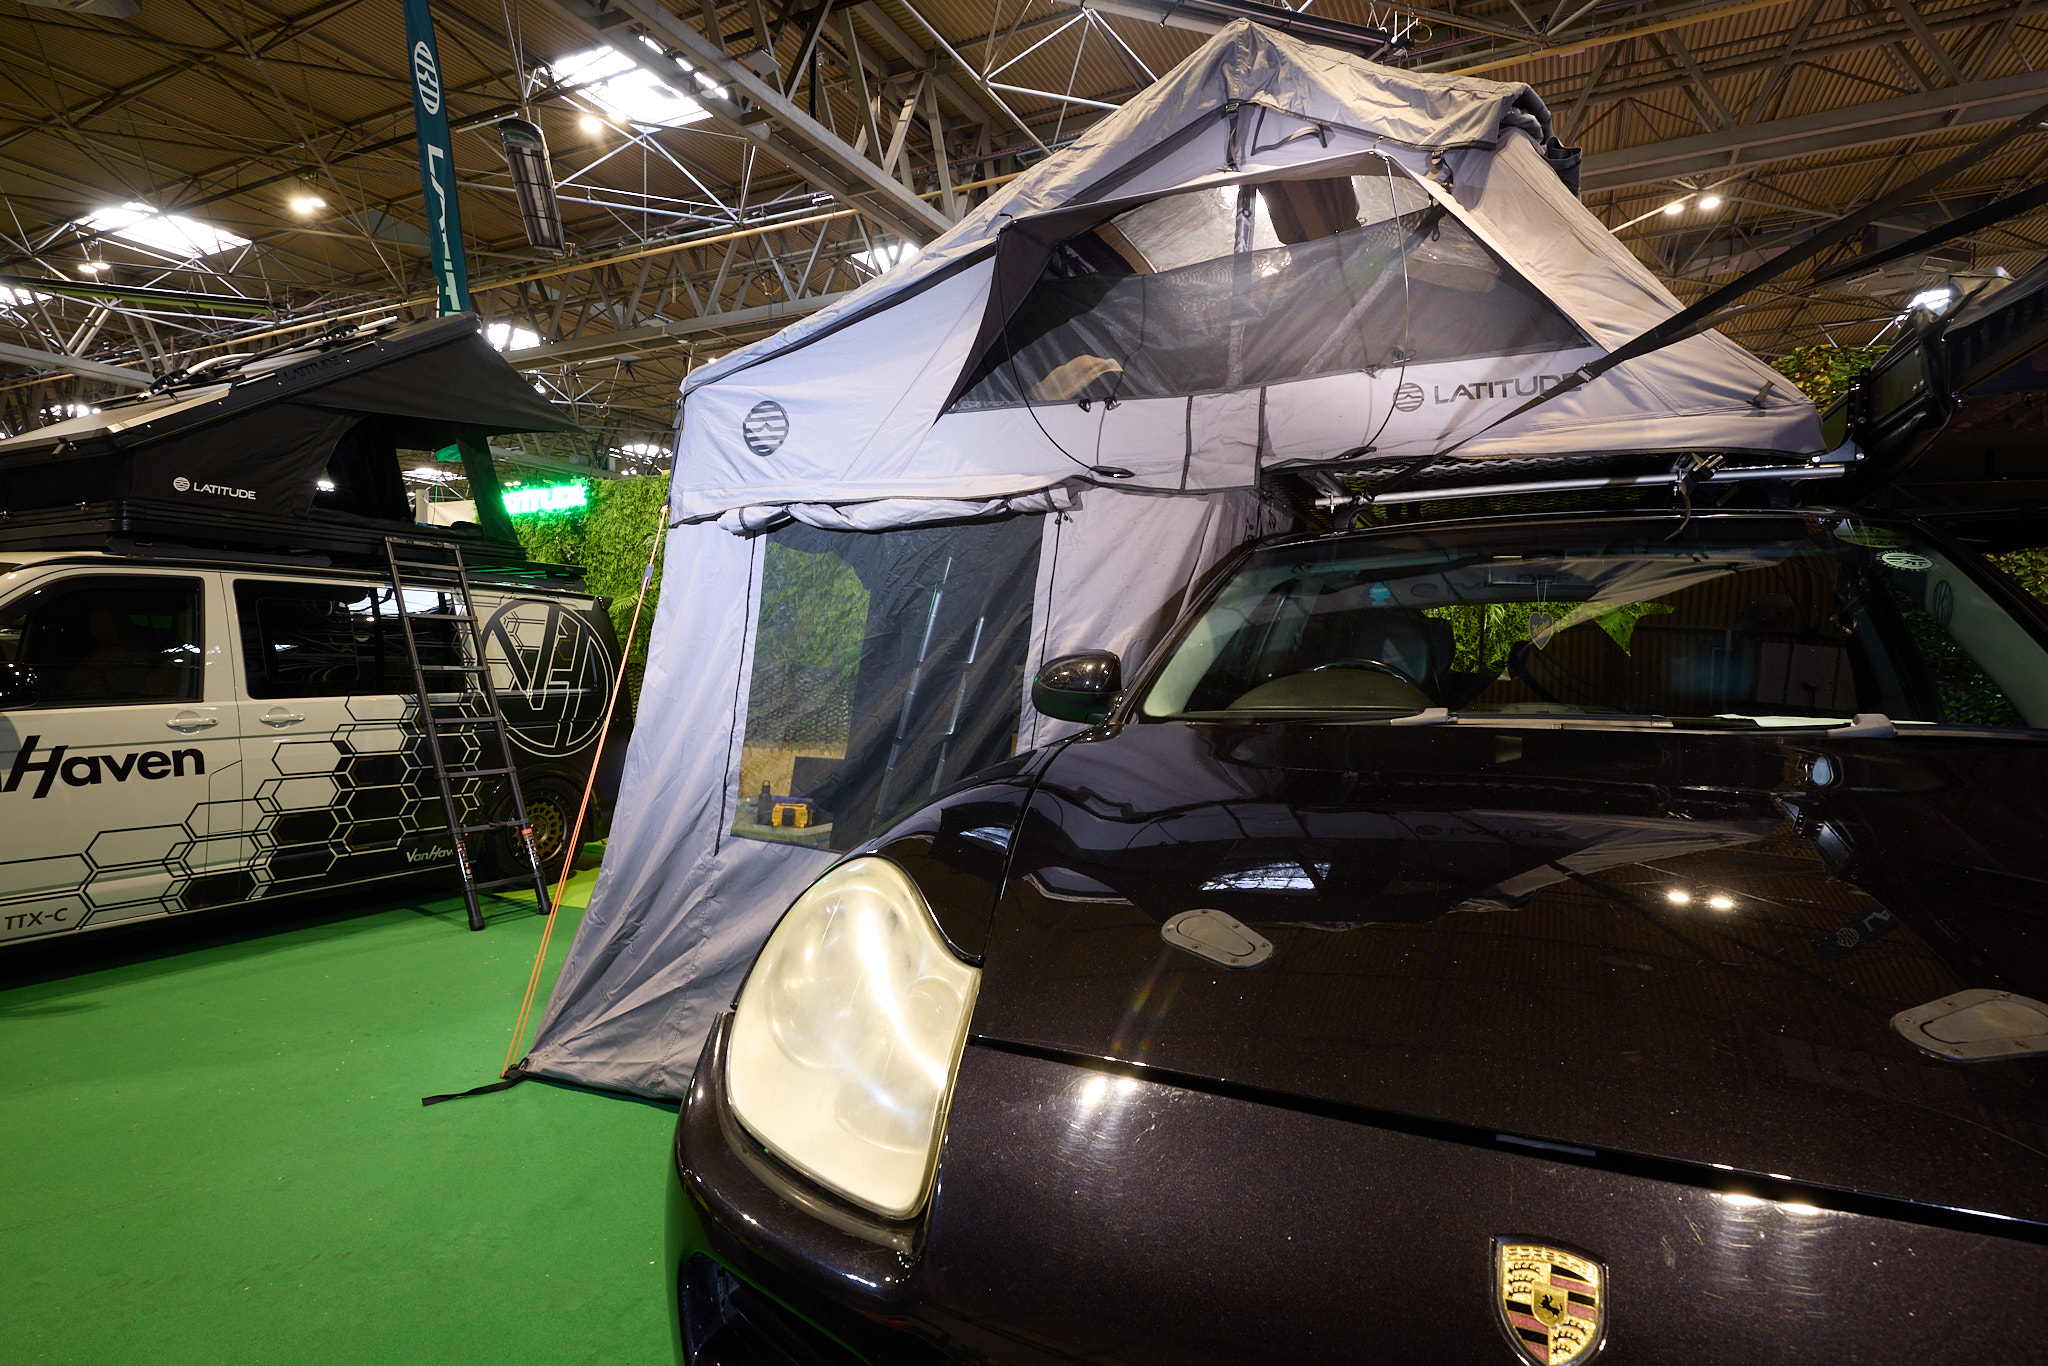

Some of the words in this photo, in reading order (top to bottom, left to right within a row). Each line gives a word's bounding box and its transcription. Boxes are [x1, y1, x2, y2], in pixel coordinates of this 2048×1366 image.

[193, 482, 256, 500] LATITUDE
[0, 735, 205, 799] Haven
[406, 844, 454, 863] VanHav
[5, 907, 68, 931] TTX-C
